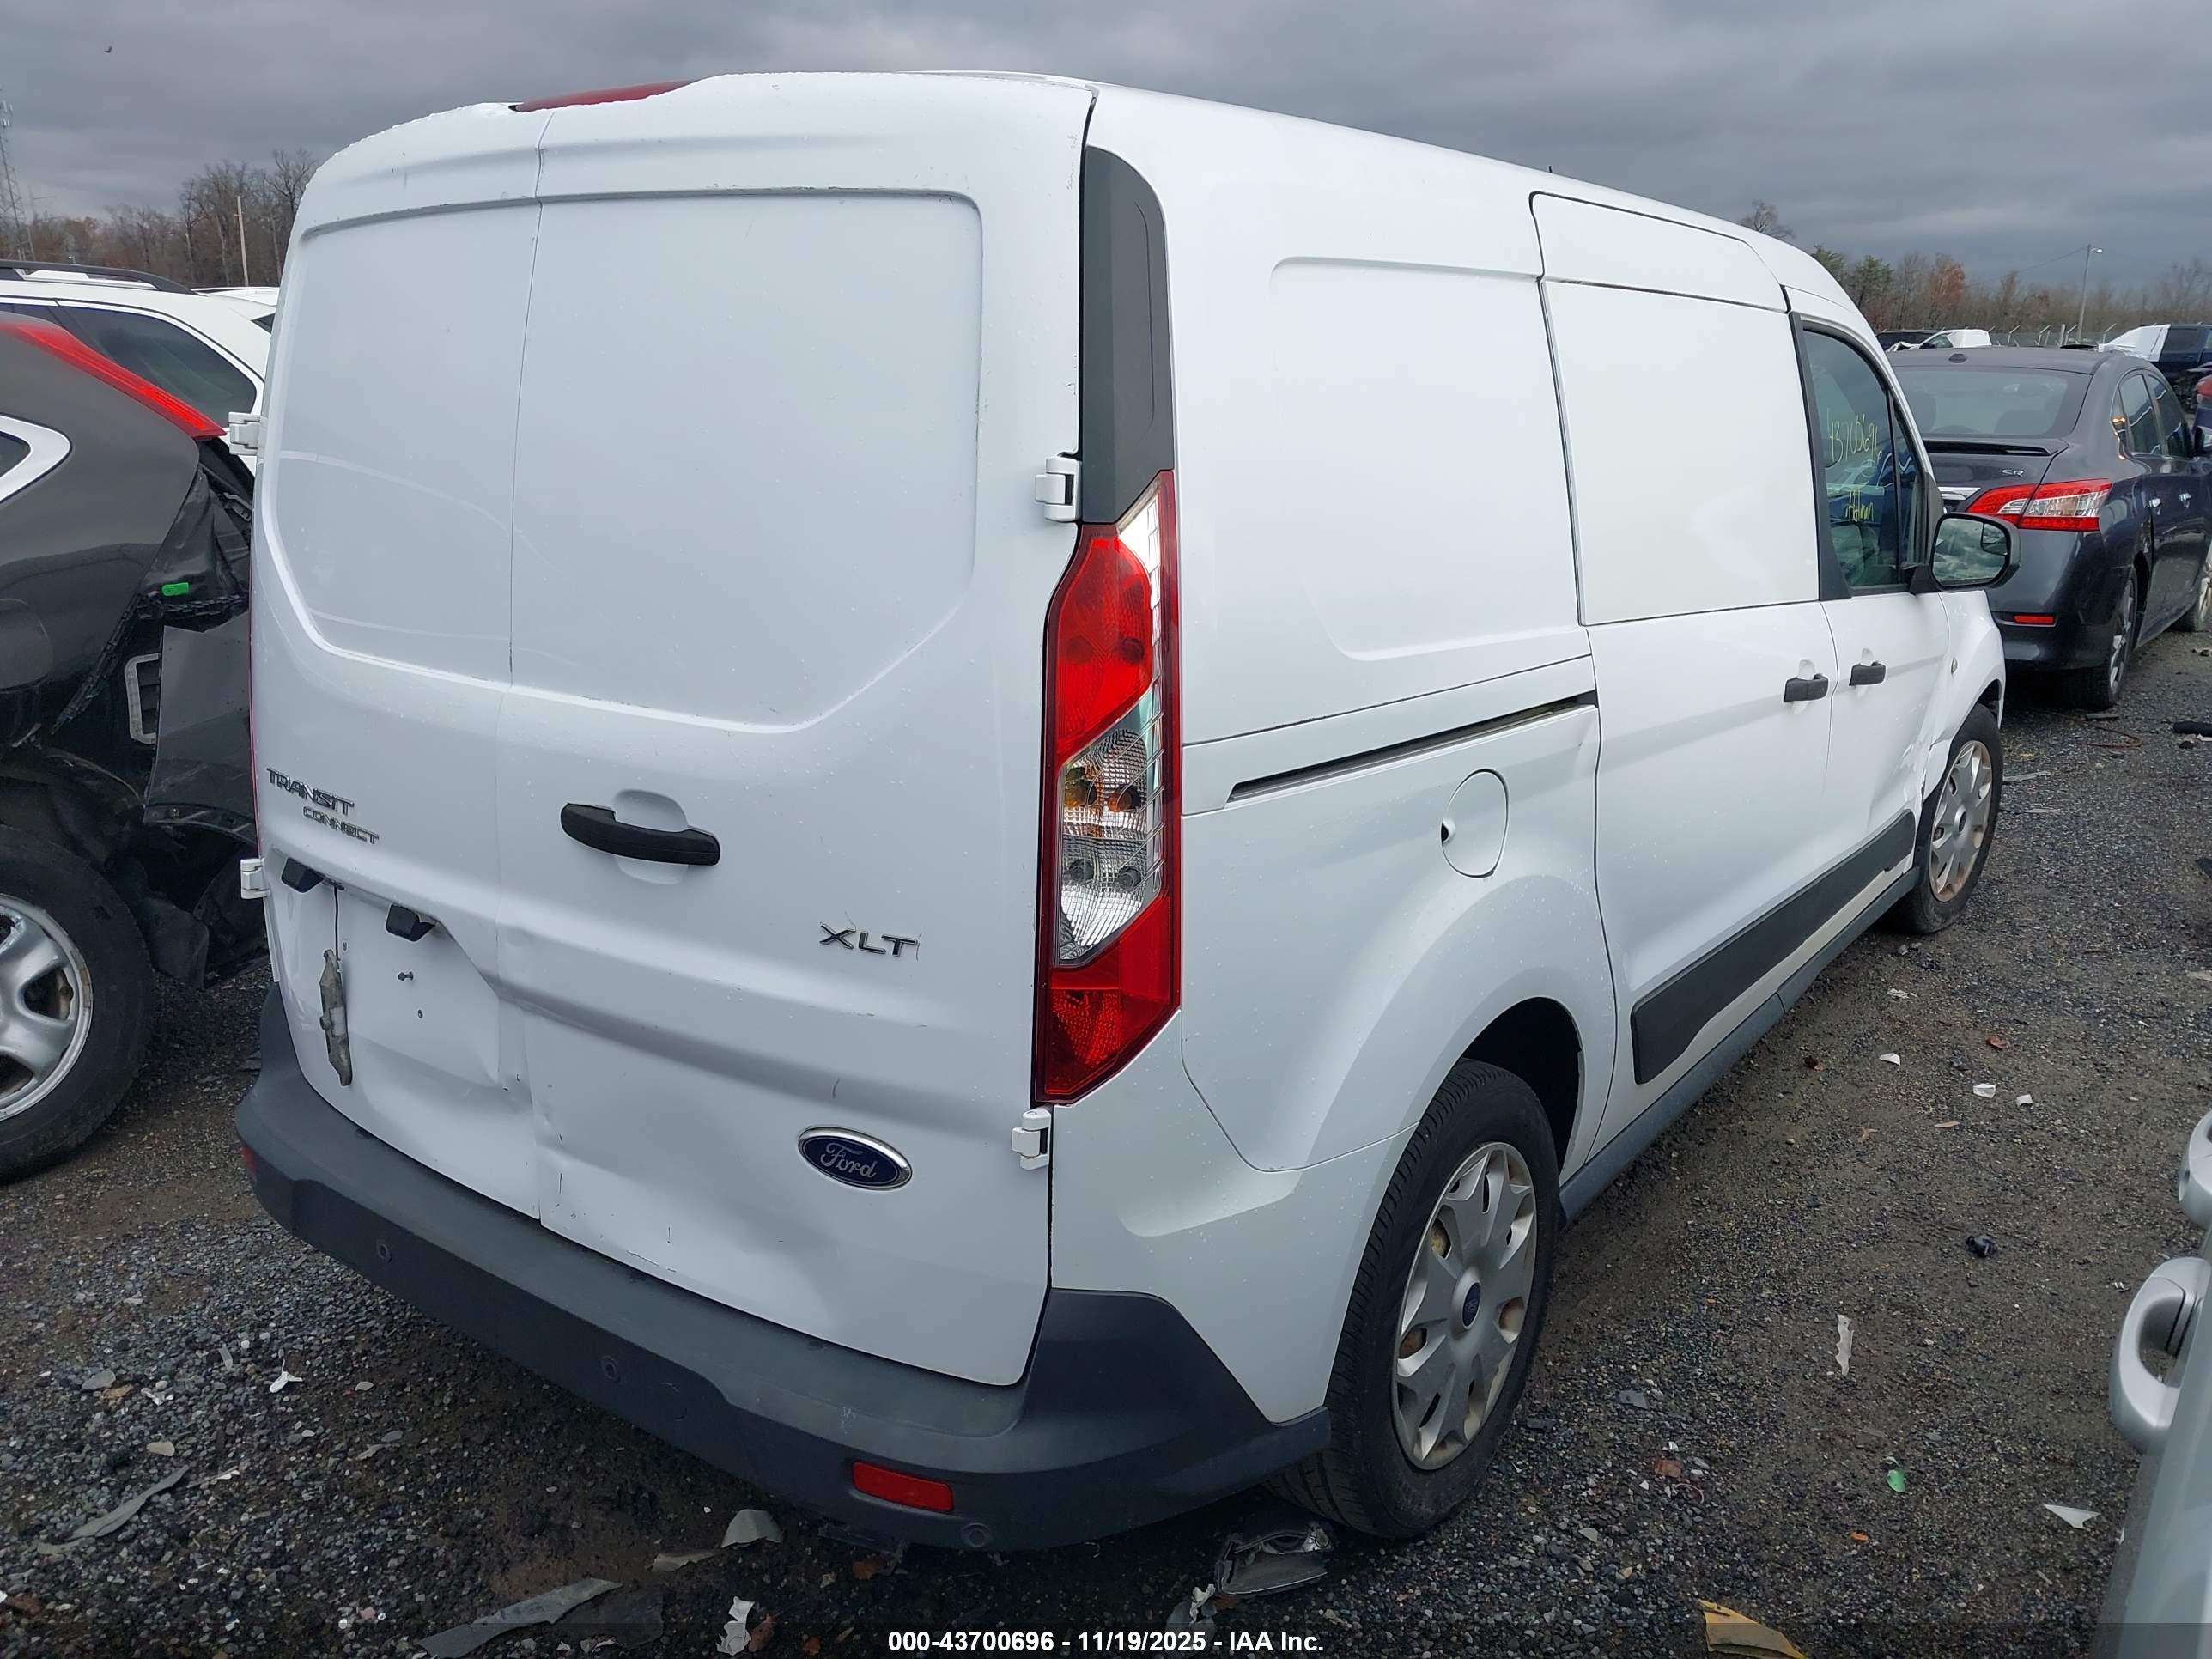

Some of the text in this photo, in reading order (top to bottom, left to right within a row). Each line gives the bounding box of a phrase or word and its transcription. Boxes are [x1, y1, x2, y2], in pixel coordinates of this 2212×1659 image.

[2002, 469, 2026, 477] SR
[266, 768, 355, 817] TRANSIT
[303, 806, 380, 845] CONNECT
[819, 922, 918, 957] XLT
[820, 1142, 878, 1179] Ford
